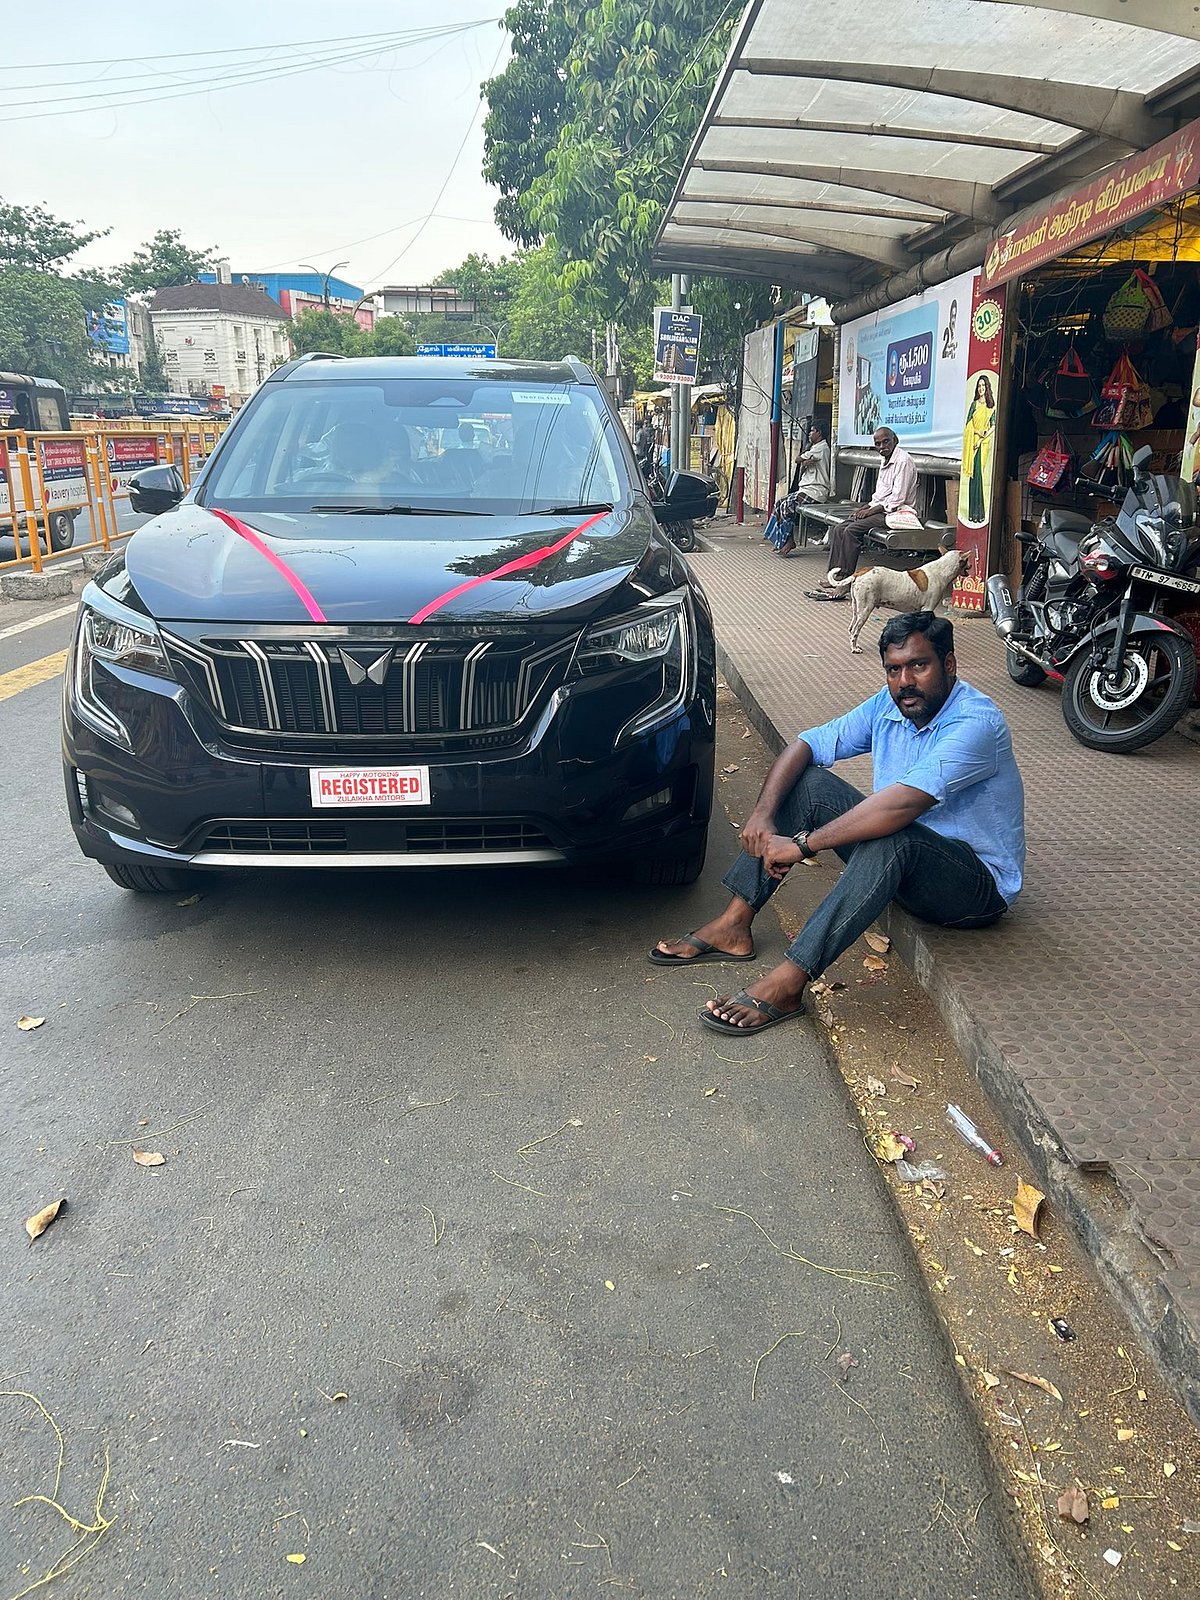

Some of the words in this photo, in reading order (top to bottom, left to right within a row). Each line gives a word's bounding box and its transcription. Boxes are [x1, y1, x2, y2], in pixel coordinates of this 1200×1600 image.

[1048, 199, 1093, 241] அதிரடி
[1095, 153, 1172, 216] விற்பனை
[671, 314, 690, 323] DAC
[976, 309, 999, 331] 30%
[1158, 575, 1170, 584] 97
[321, 777, 420, 795] REGISTERED
